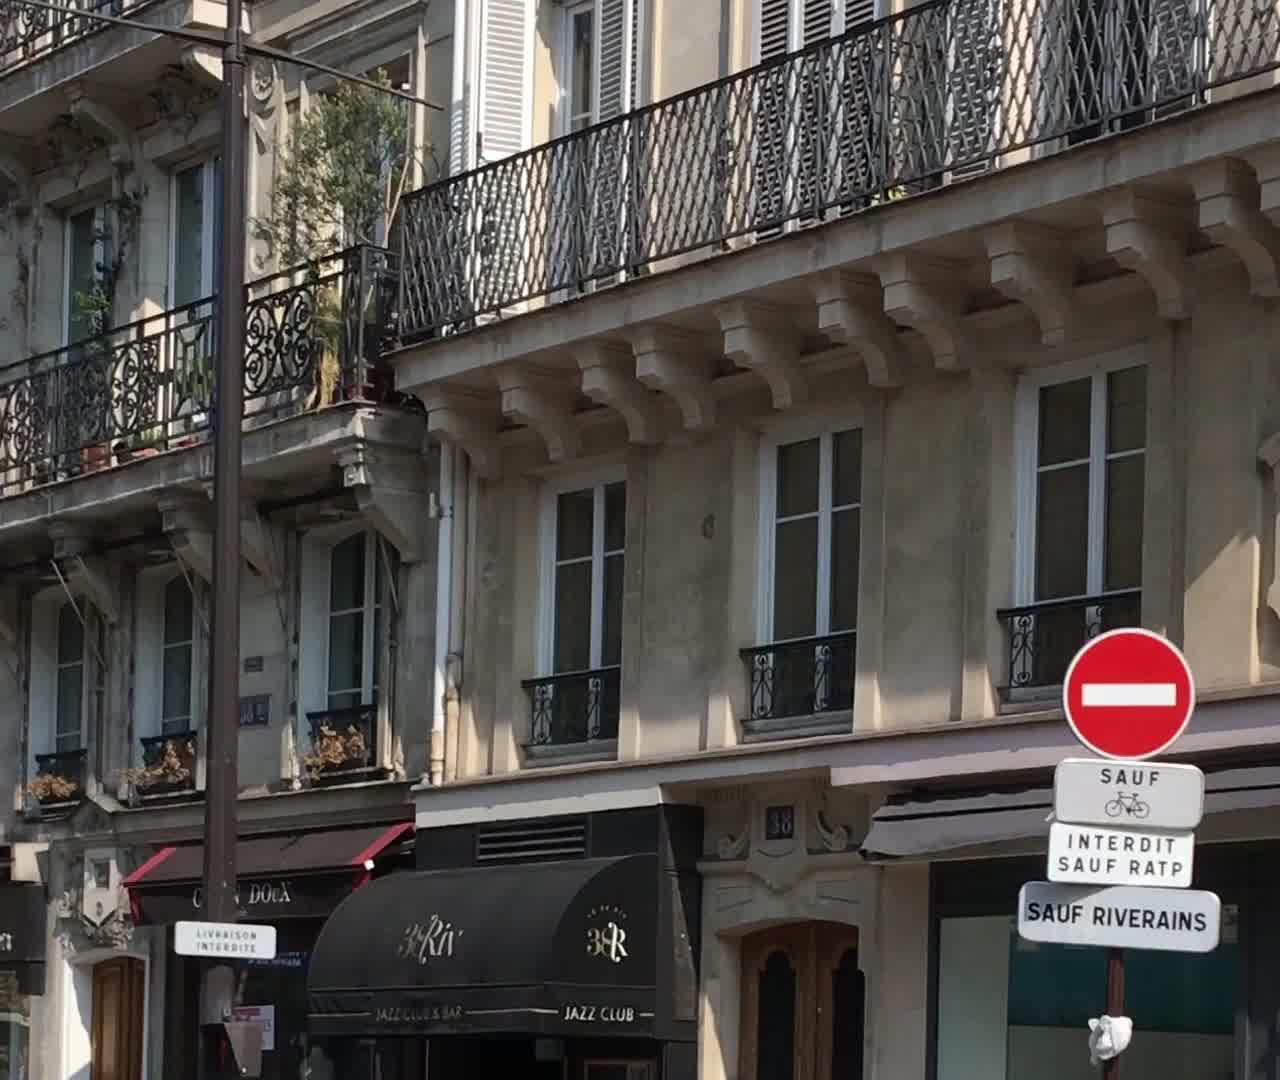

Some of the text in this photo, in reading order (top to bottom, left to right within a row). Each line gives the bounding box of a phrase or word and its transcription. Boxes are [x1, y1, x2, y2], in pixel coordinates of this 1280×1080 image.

[1100, 768, 1160, 786] SAUF
[1068, 833, 1175, 855] INTERDIT
[1058, 856, 1183, 877] SAUF RATP
[1027, 902, 1207, 932] SAUF RIVERAINS
[196, 927, 258, 941] LIVRAISON
[196, 942, 257, 954] INTERDITE
[564, 1006, 634, 1022] JAZZ CLUB
